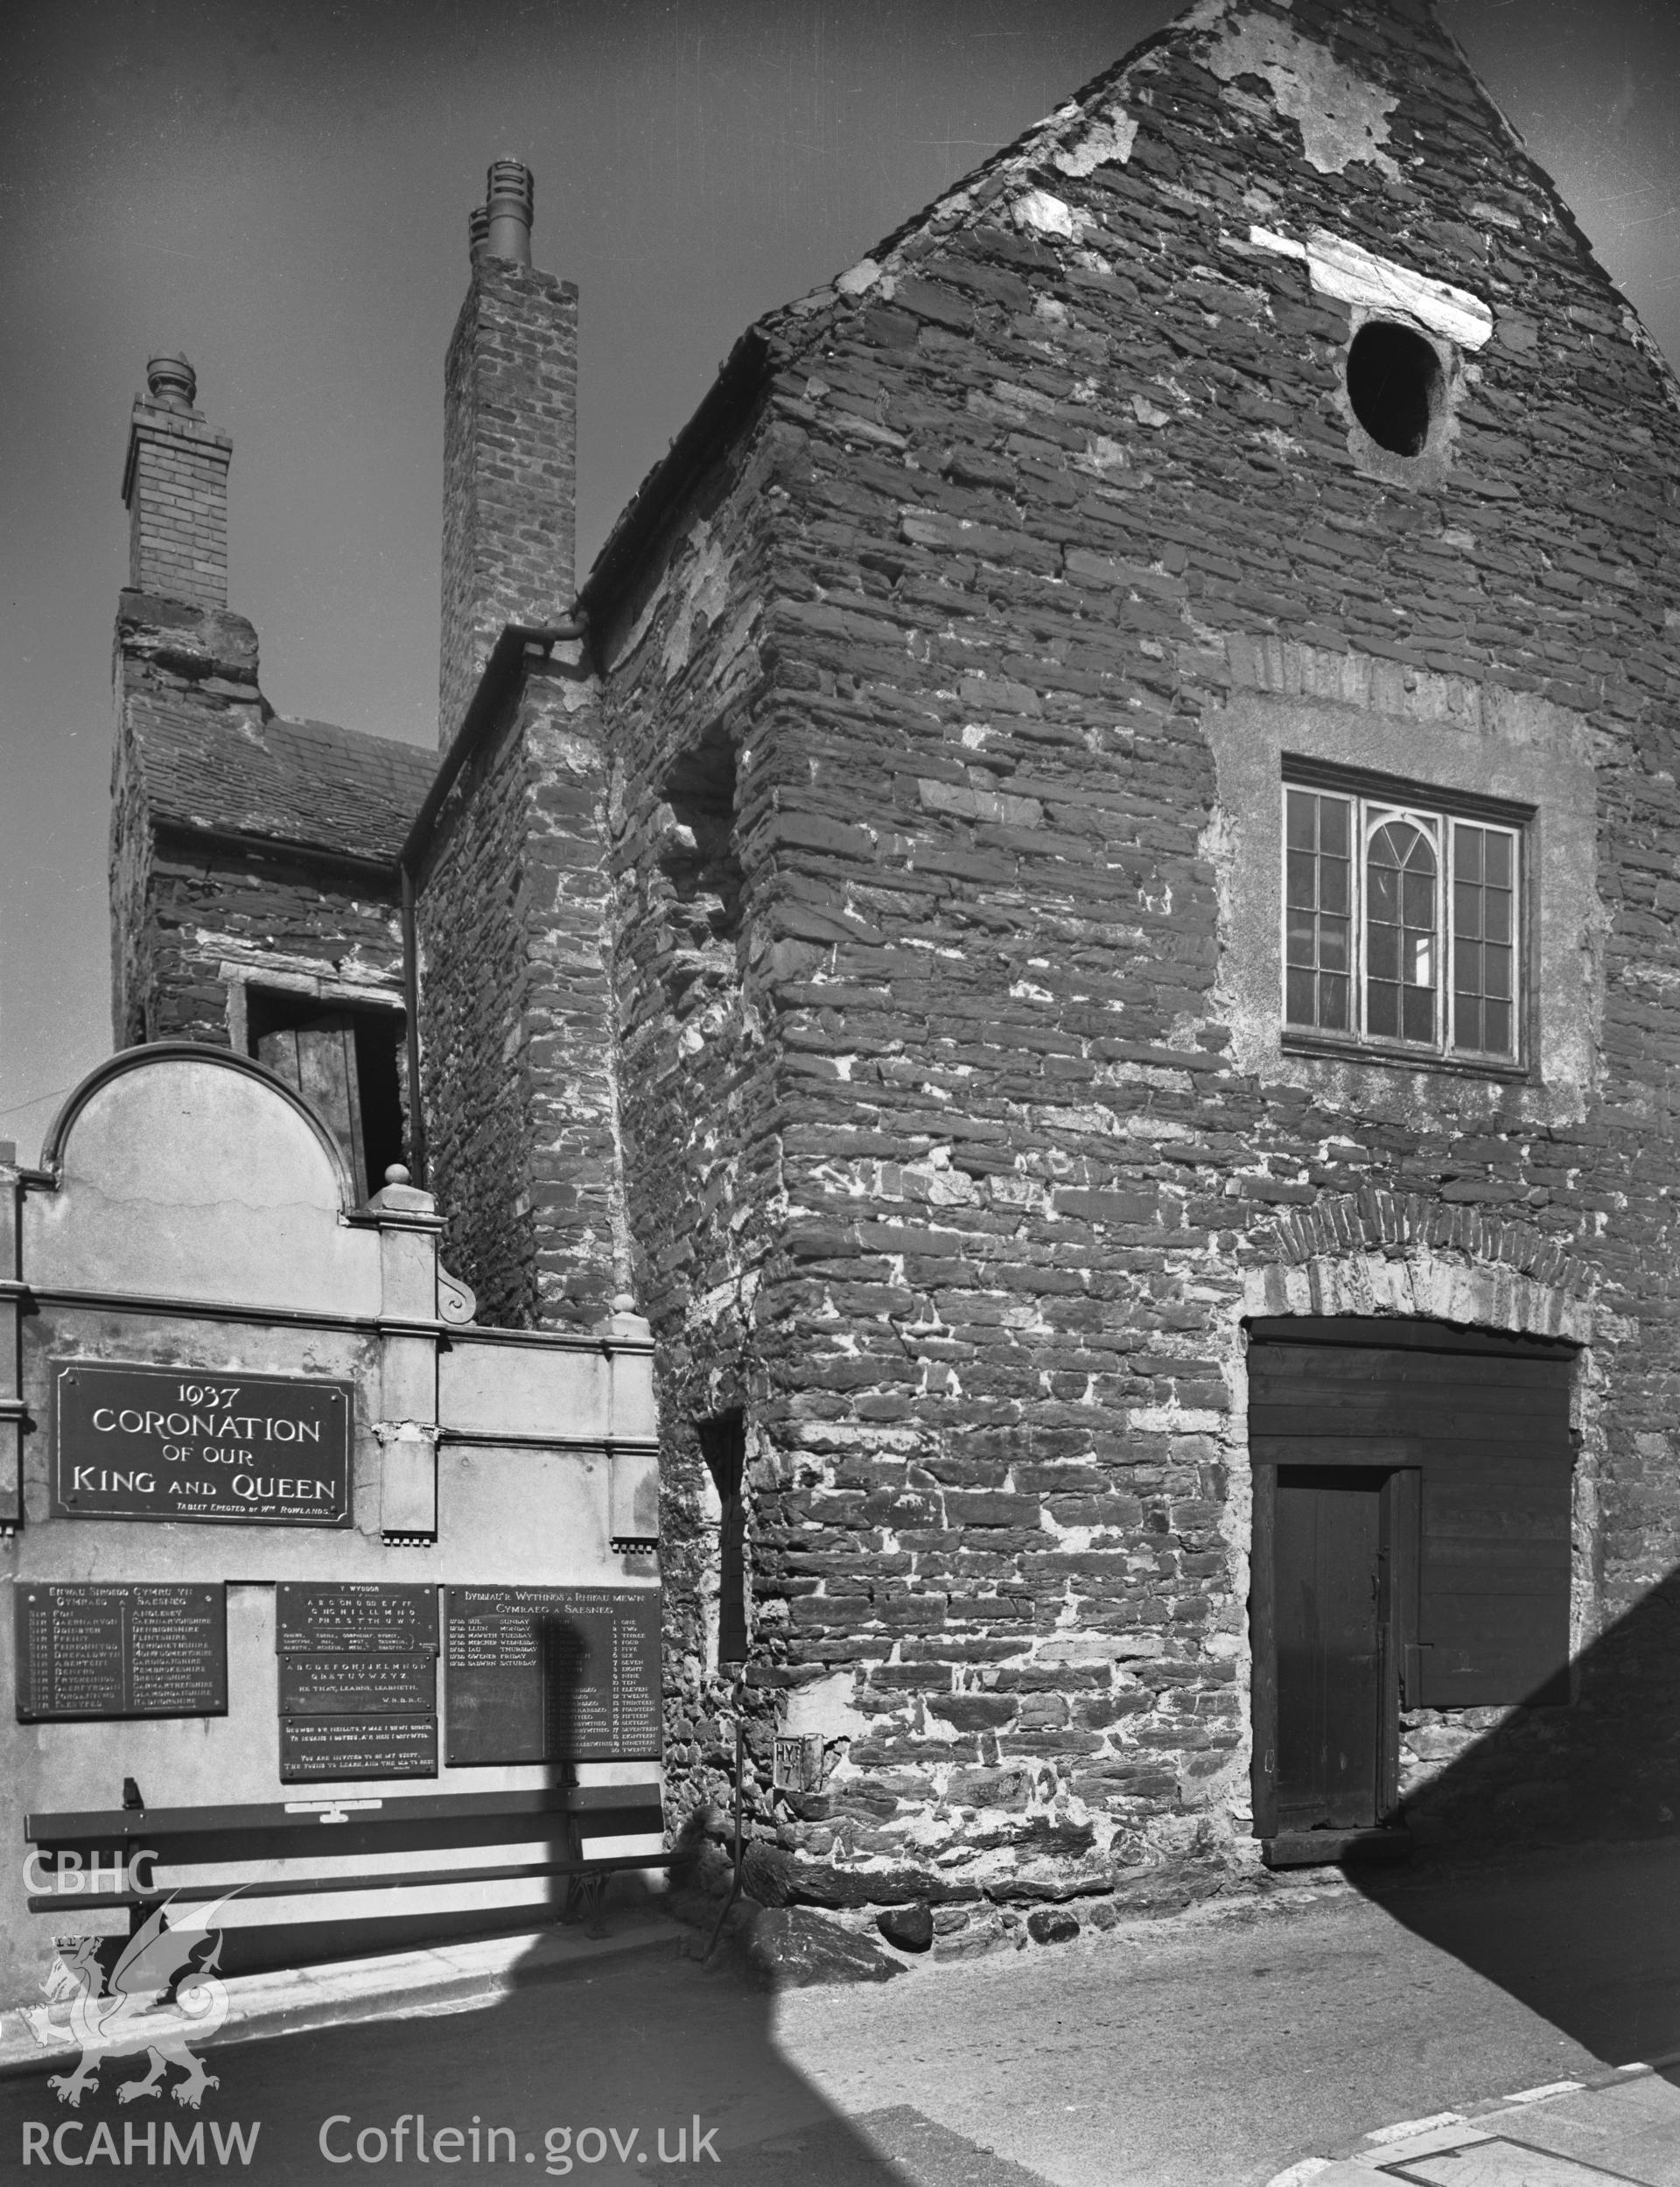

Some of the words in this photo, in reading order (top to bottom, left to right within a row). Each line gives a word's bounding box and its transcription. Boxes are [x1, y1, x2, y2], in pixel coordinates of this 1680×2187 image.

[178, 1384, 241, 1409] 1937
[92, 1408, 321, 1443] CORONATION
[162, 1444, 194, 1462] OF
[202, 1446, 255, 1467] OUR
[73, 1465, 158, 1493] KING
[168, 1481, 217, 1496] AND
[231, 1474, 336, 1501] QUEEN
[177, 1502, 208, 1511] TABLET
[210, 1503, 246, 1513] ERECTED
[516, 1591, 565, 1602] WYTHNOS
[495, 1603, 550, 1614] CYMRAEG
